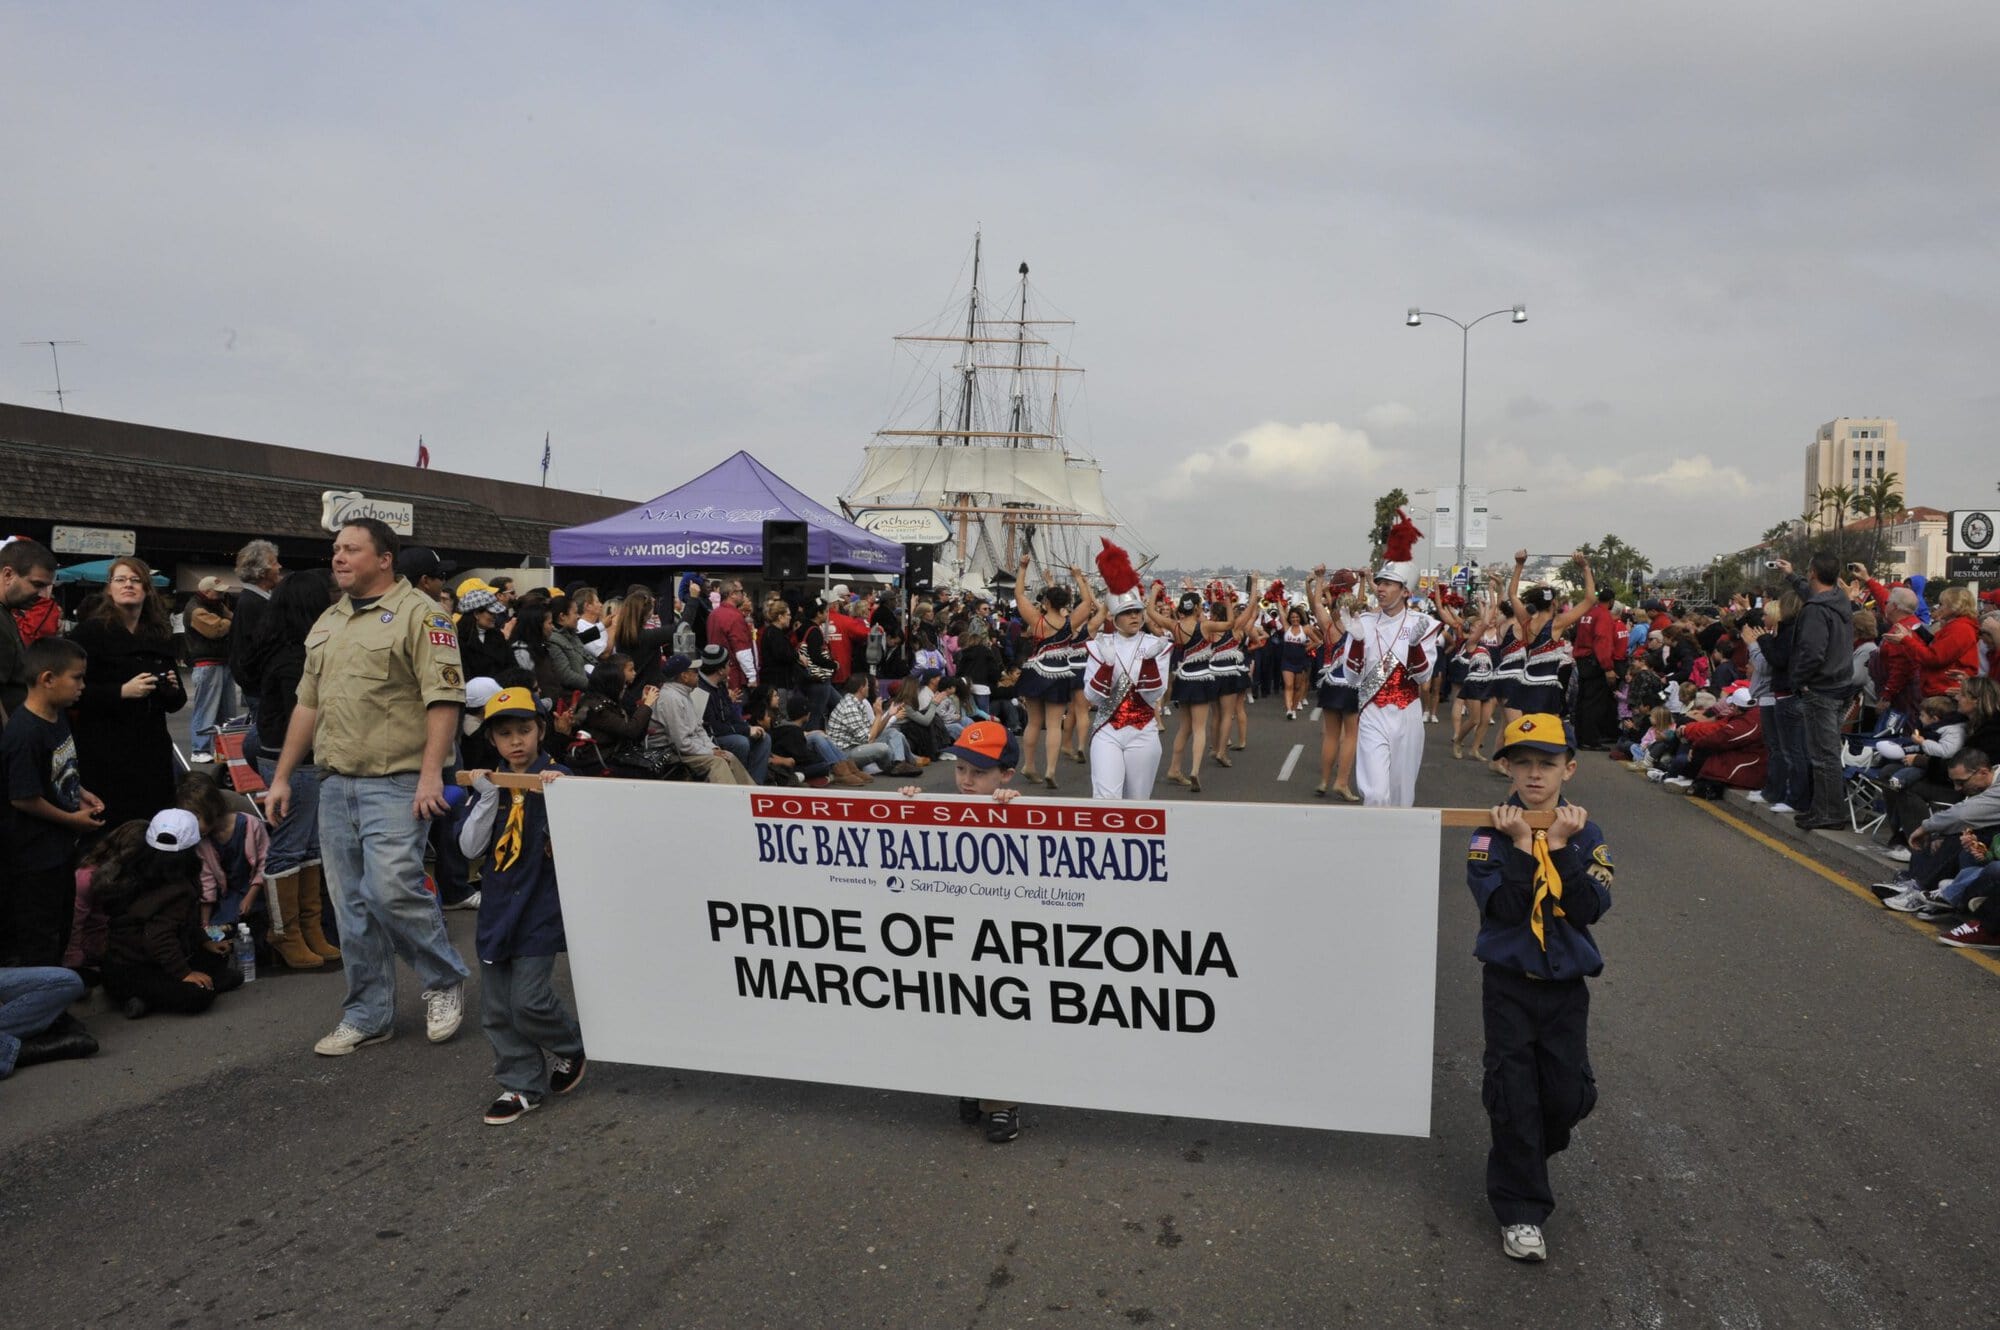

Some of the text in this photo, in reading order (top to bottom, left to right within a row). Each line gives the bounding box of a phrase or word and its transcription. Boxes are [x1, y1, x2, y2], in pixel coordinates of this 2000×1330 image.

[332, 495, 410, 529] Anthony's
[864, 513, 933, 532] Anthony's
[757, 799, 1158, 830] PORT OF SAN DIEGO
[755, 823, 1168, 882] BIG BAY BALLOON PARADE
[829, 875, 877, 887] Presented by
[910, 879, 1085, 902] San Diego County Credit Union
[707, 900, 1239, 978] PRIDE OF ARIZONA
[734, 956, 1216, 1034] MARCHING BAND
